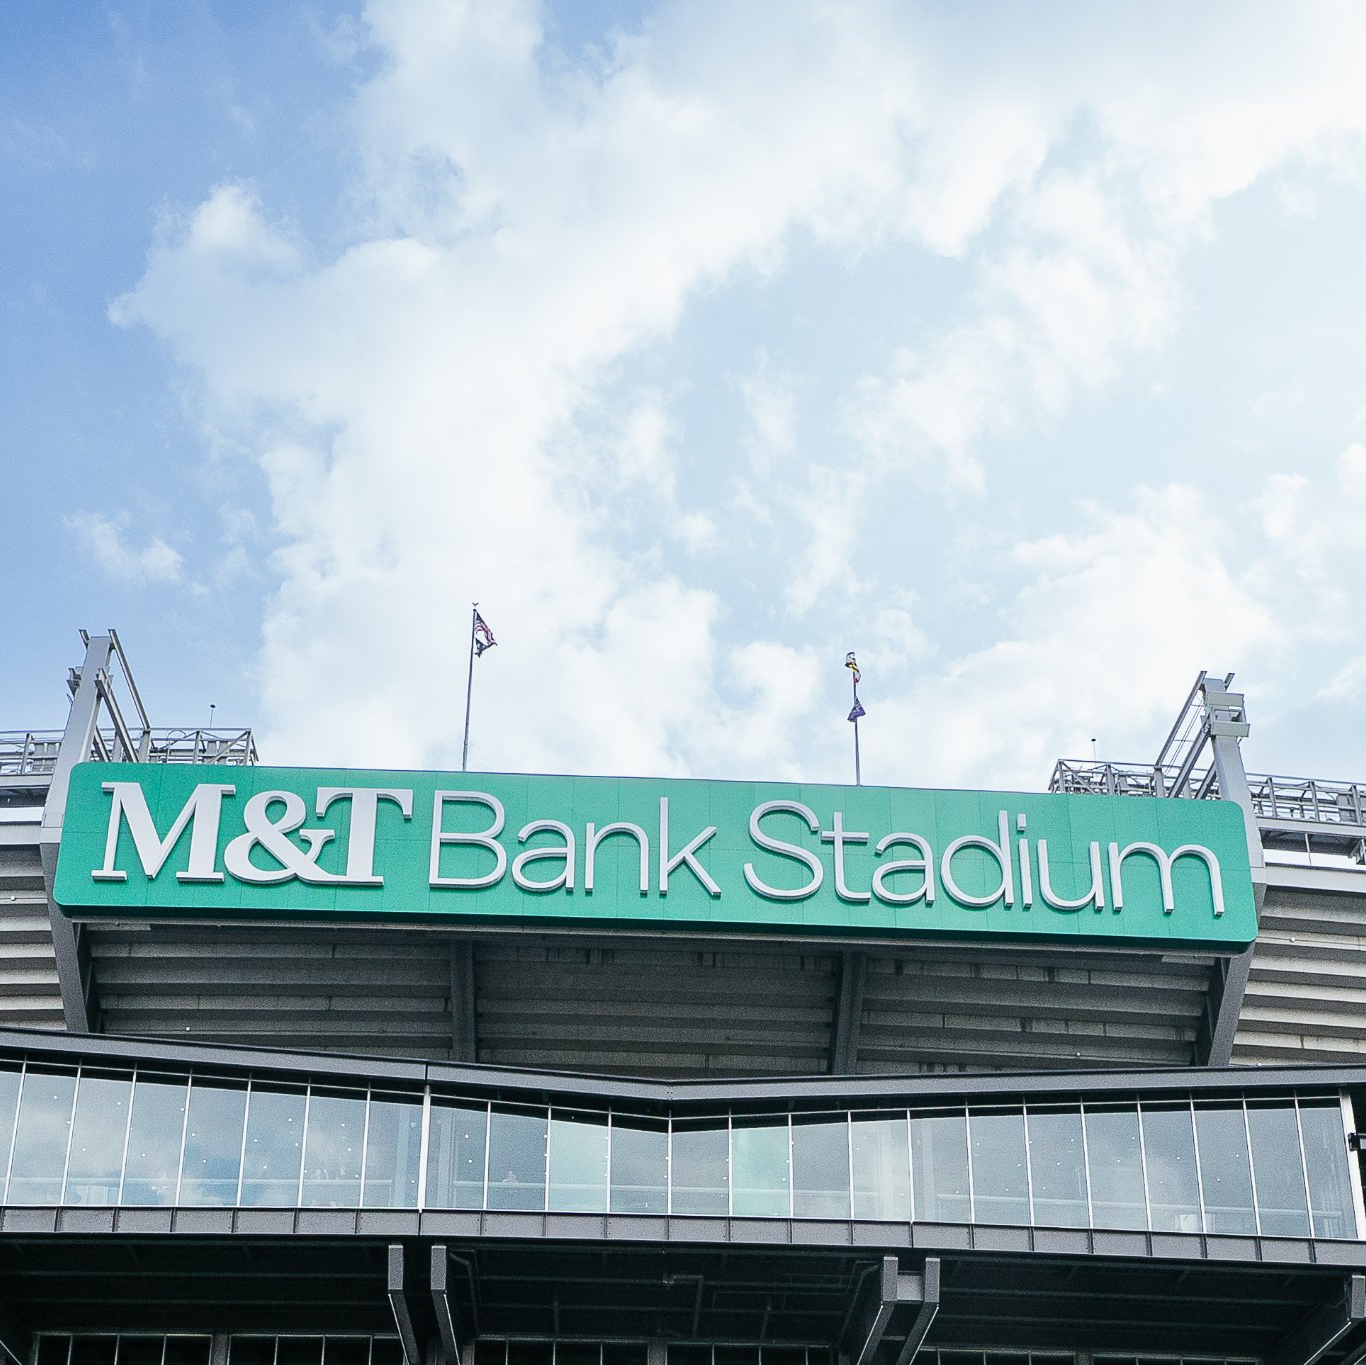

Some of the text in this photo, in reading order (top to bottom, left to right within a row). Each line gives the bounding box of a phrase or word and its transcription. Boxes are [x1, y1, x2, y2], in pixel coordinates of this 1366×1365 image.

[91, 782, 1226, 916] M&T Bank Stadium
